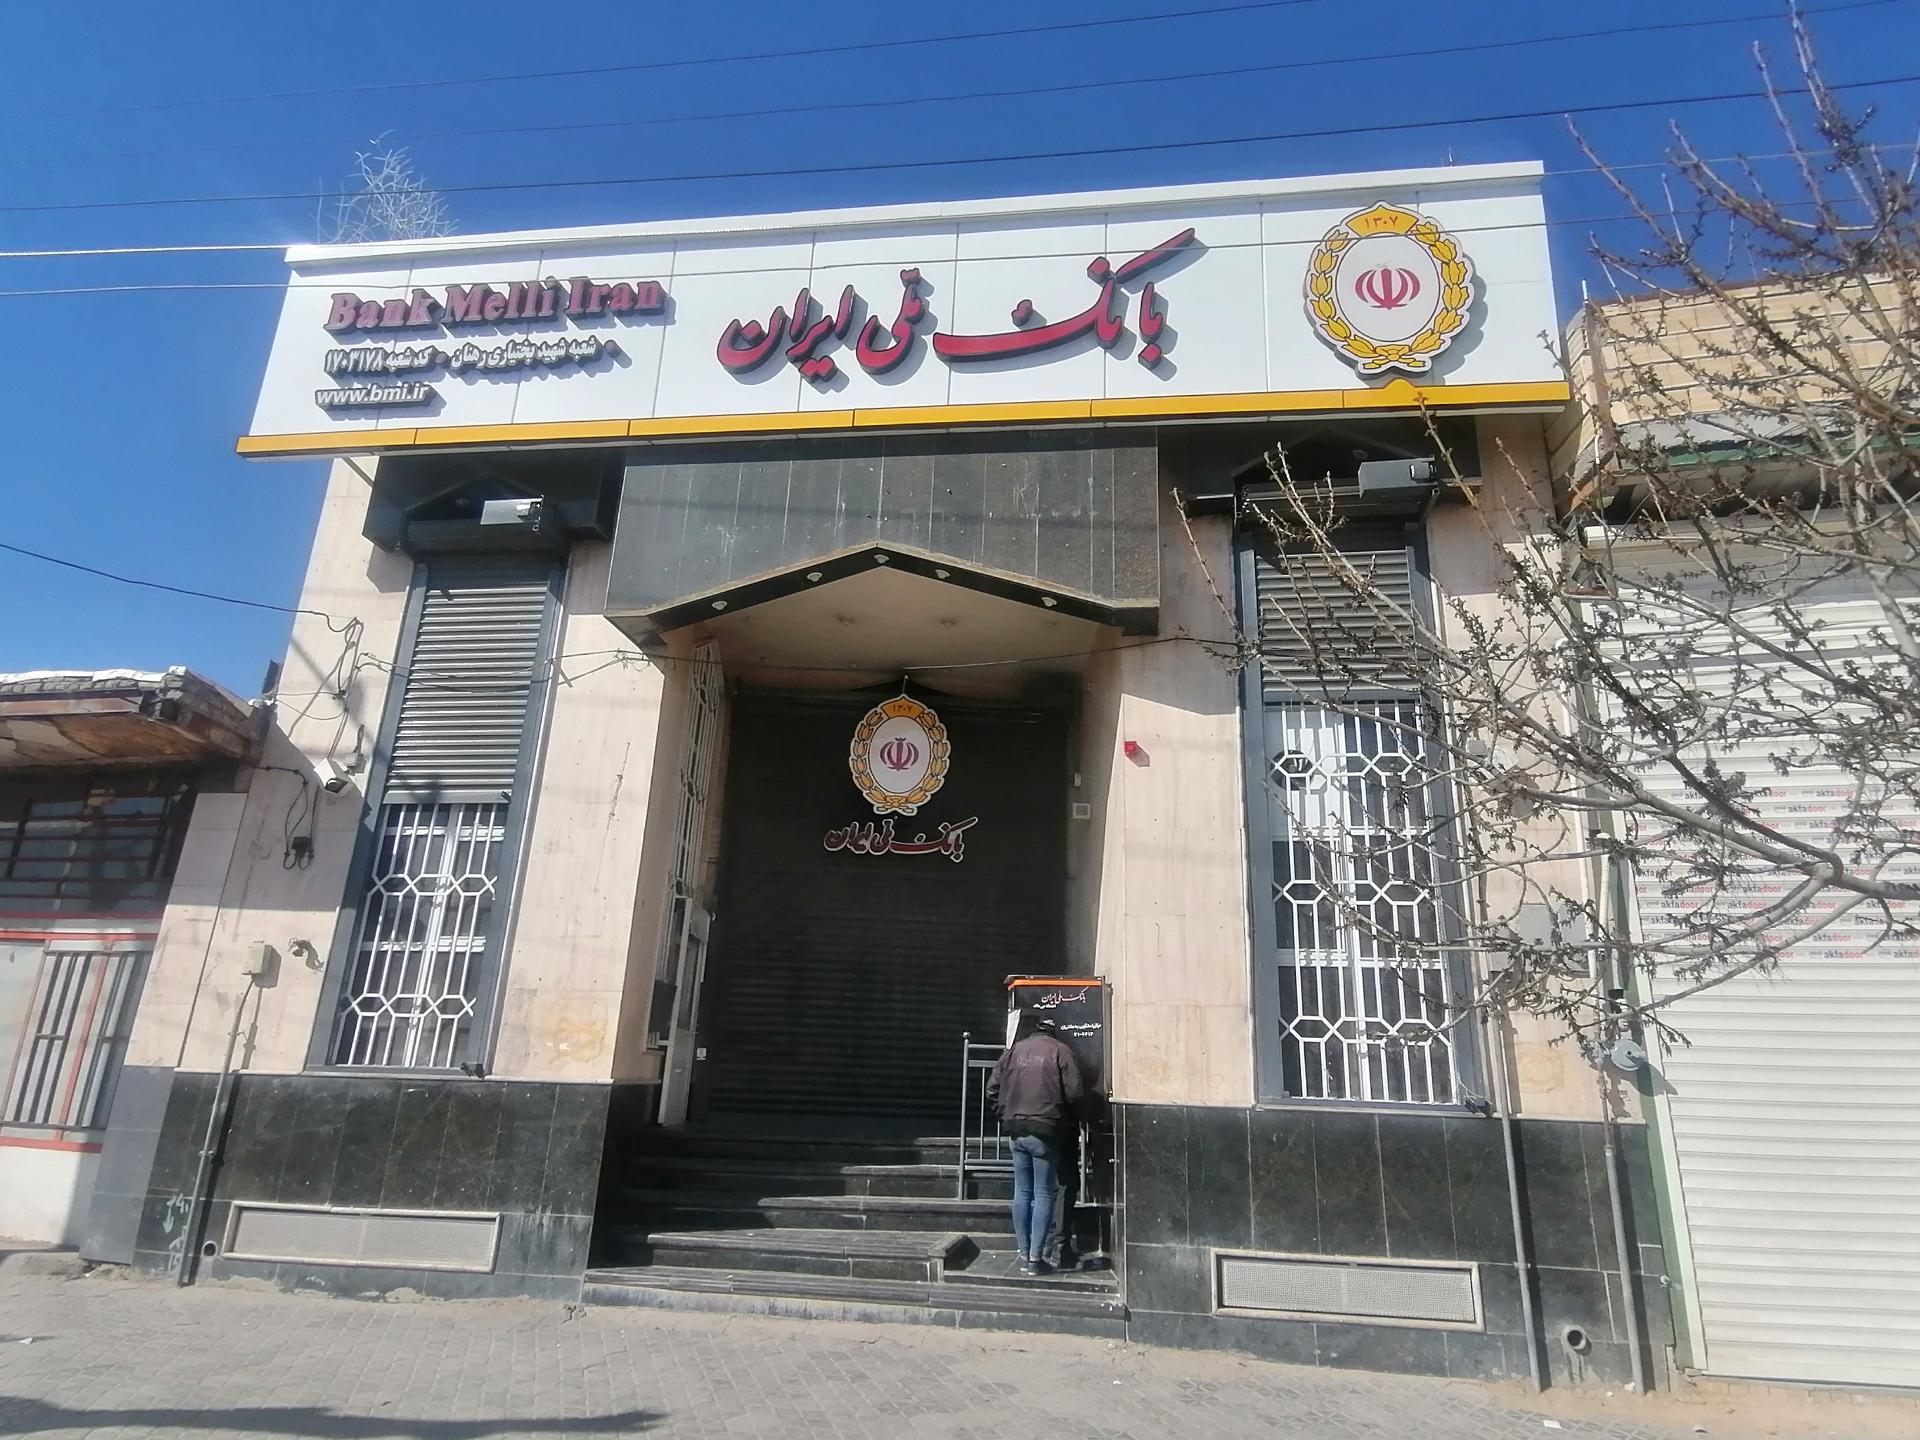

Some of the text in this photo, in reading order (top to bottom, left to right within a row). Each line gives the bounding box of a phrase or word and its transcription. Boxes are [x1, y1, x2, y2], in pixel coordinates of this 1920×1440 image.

[324, 276, 665, 332] Bank Melli Iran
[933, 228, 1196, 370] بانک
[717, 284, 855, 384] ایران
[568, 335, 597, 362] شعبه
[315, 382, 430, 405] www.bmi.ir
[1788, 804, 1826, 813] akfadoor
[824, 821, 875, 854] ایران
[890, 816, 979, 863] بانک
[1743, 885, 1782, 893] akfadoor
[1661, 900, 1698, 909] akfadoor
[1728, 901, 1767, 909] akfadoor
[1812, 933, 1852, 941] akfadoor
[1824, 949, 1864, 958] akfadoor
